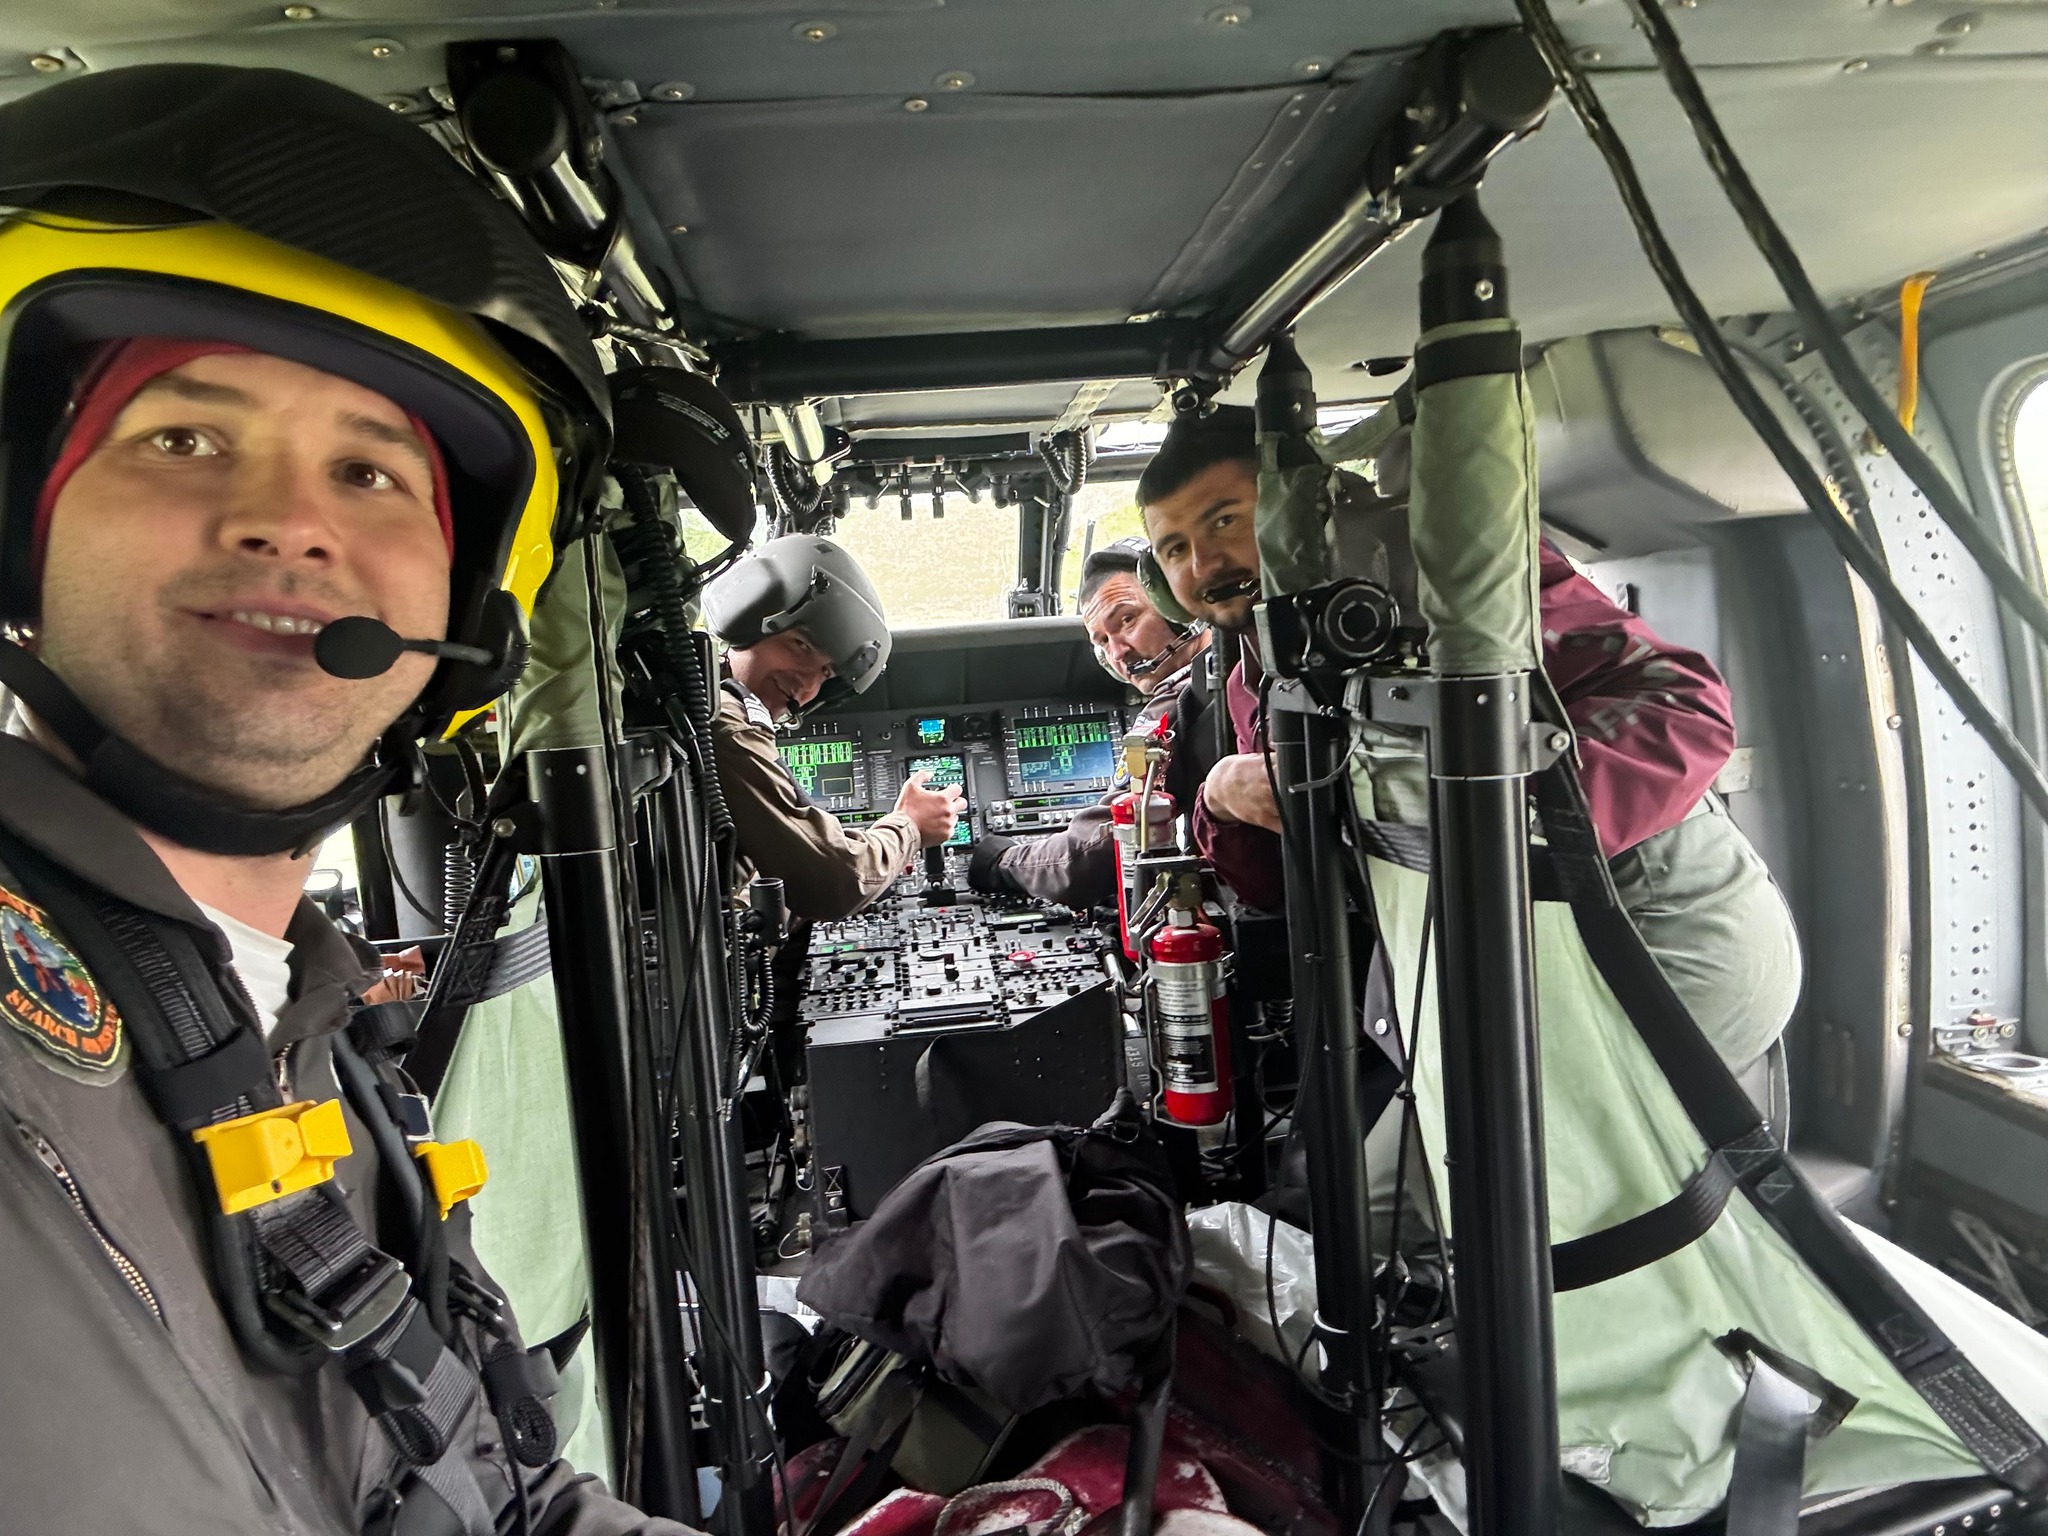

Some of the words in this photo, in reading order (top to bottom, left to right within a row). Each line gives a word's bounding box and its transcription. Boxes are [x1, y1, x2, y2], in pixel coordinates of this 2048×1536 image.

[5, 988, 79, 1048] SEARCH
[1125, 1045, 1145, 1068] STEP
[1137, 1073, 1151, 1088] NO
